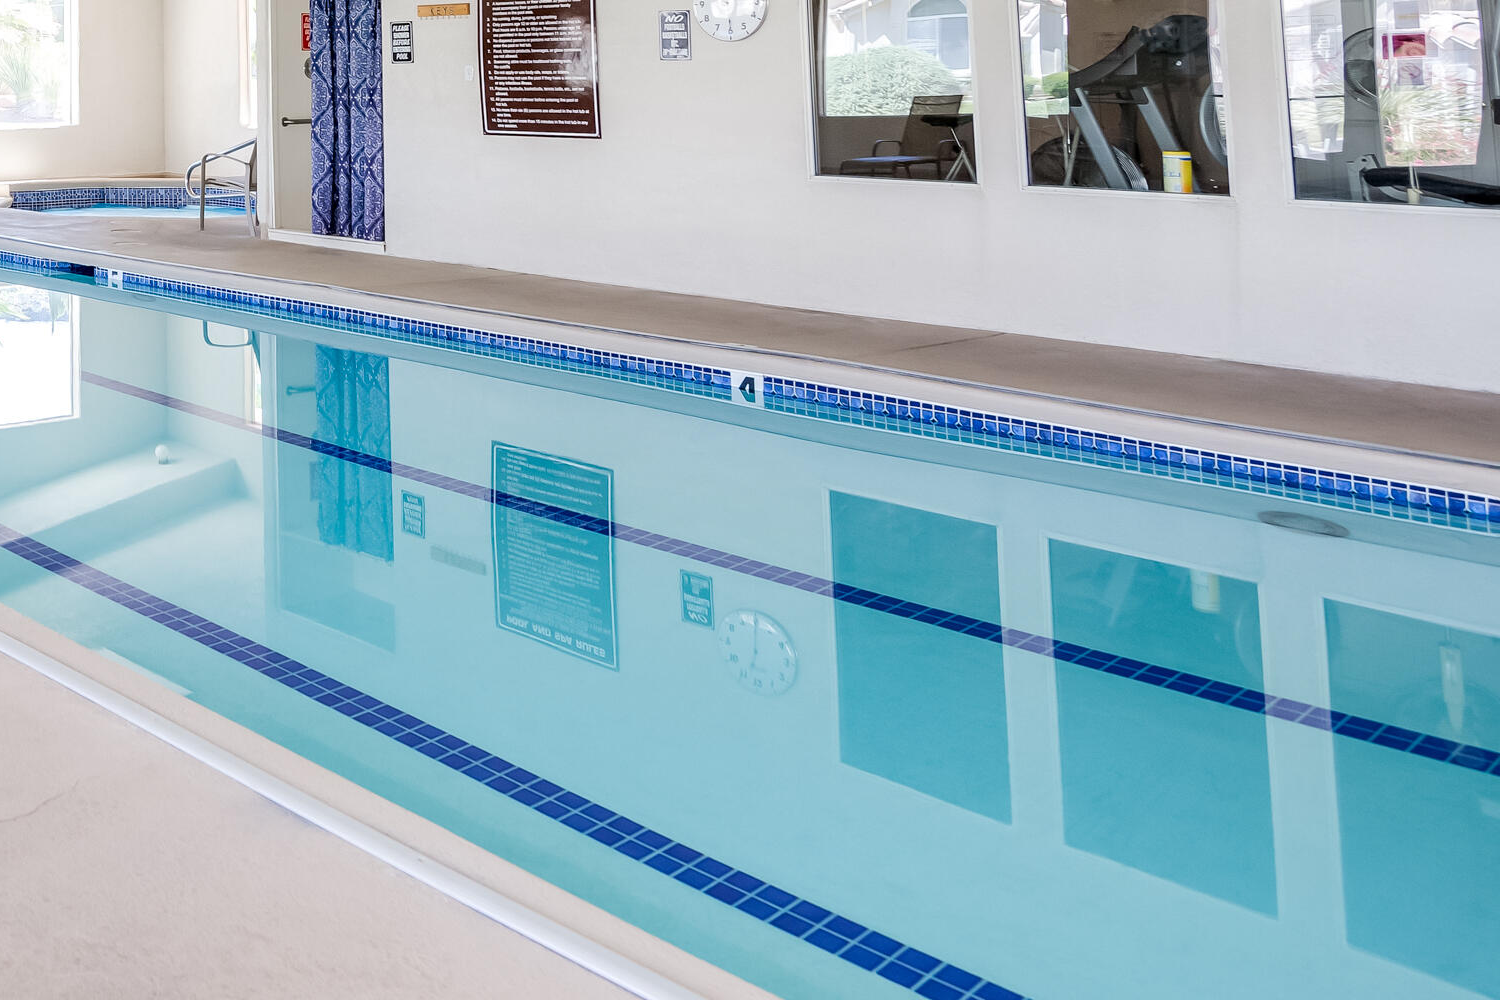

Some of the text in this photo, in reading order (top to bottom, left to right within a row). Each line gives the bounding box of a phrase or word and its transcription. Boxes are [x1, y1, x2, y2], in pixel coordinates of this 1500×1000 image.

[429, 6, 454, 16] KEYS
[665, 14, 684, 22] NO
[728, 26, 733, 34] 6
